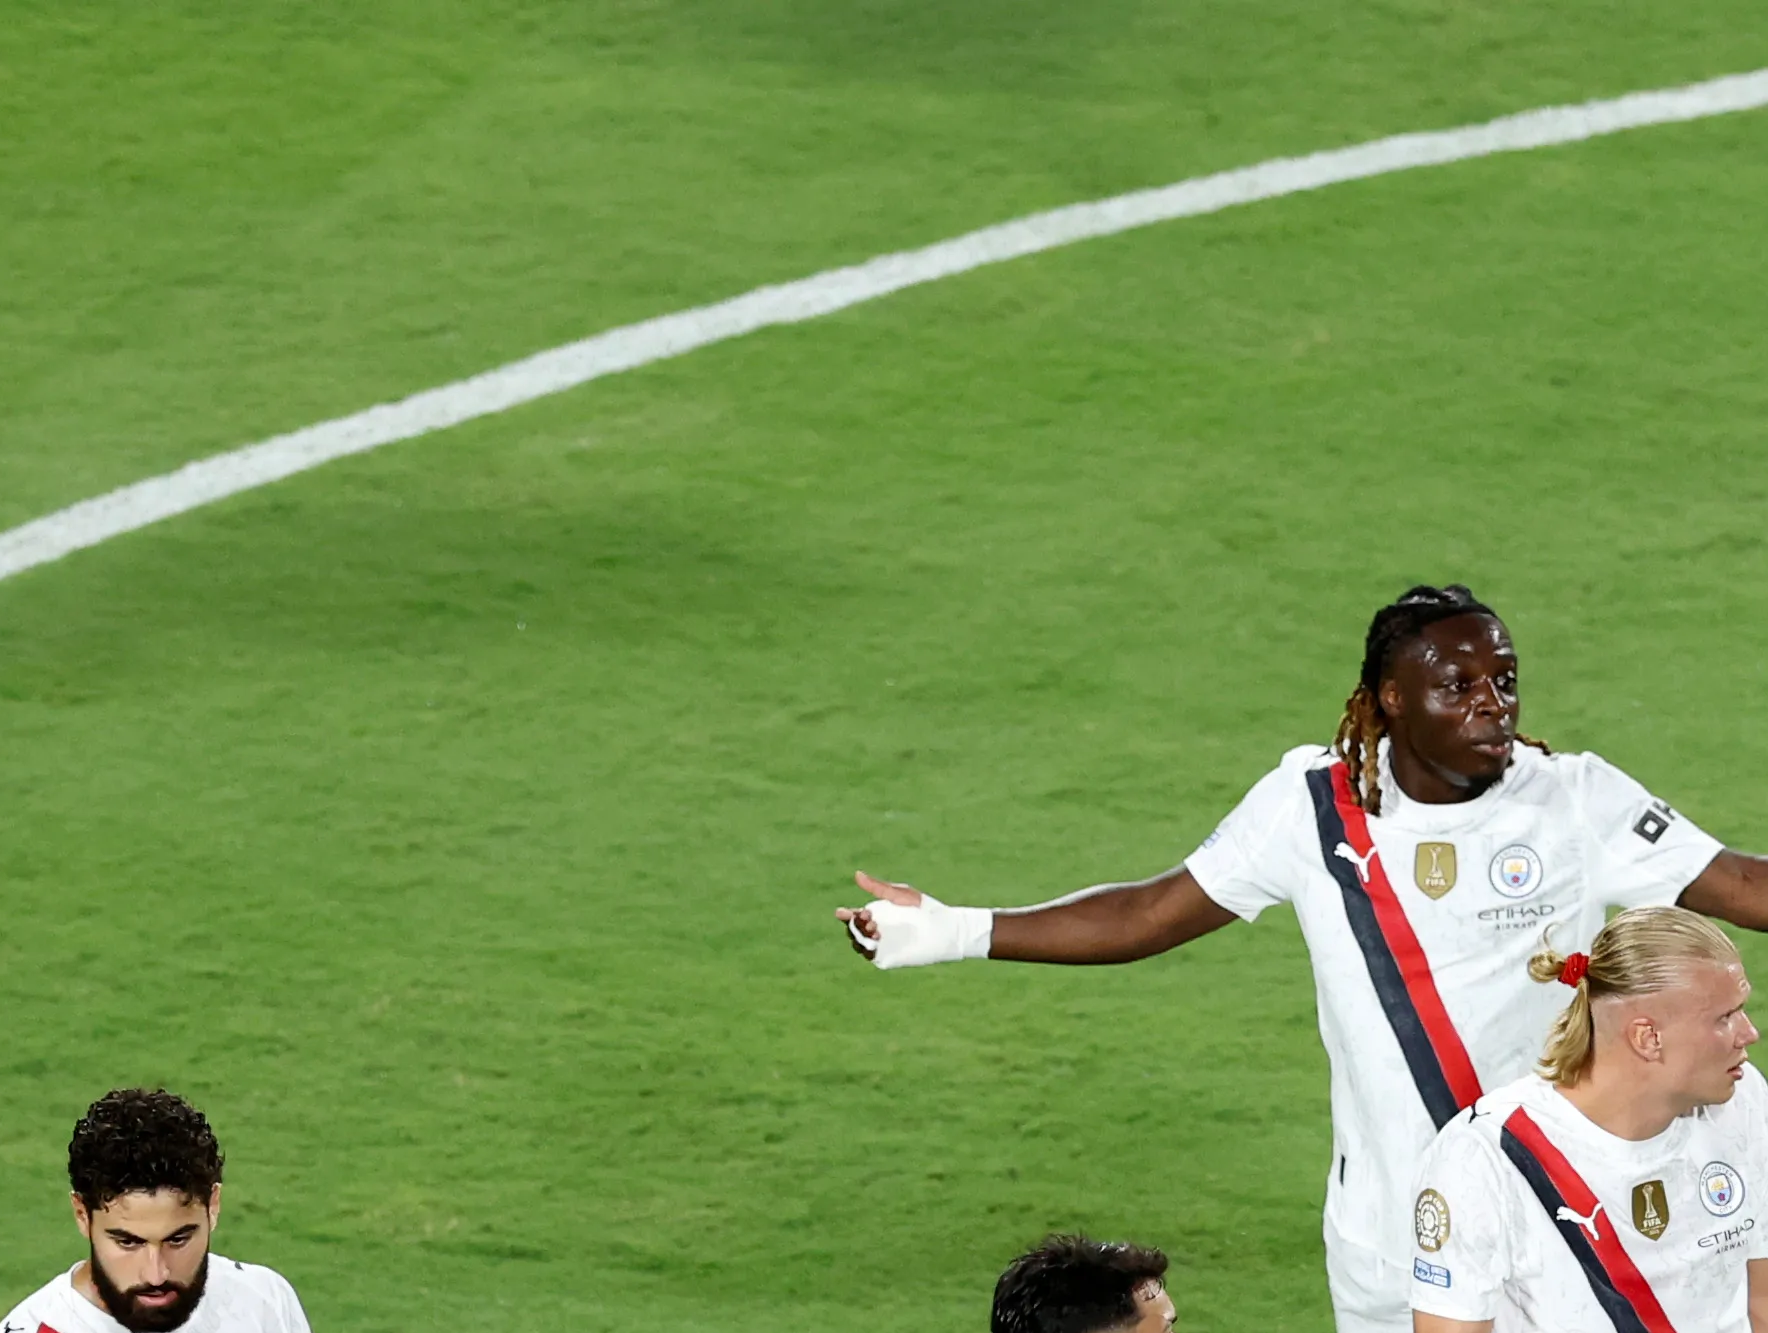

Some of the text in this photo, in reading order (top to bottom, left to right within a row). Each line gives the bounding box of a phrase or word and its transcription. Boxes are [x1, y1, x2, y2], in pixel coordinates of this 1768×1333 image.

[1477, 904, 1555, 921] ETIHAD
[1642, 1217, 1661, 1229] FIFA
[1697, 1218, 1755, 1249] ETIHAD
